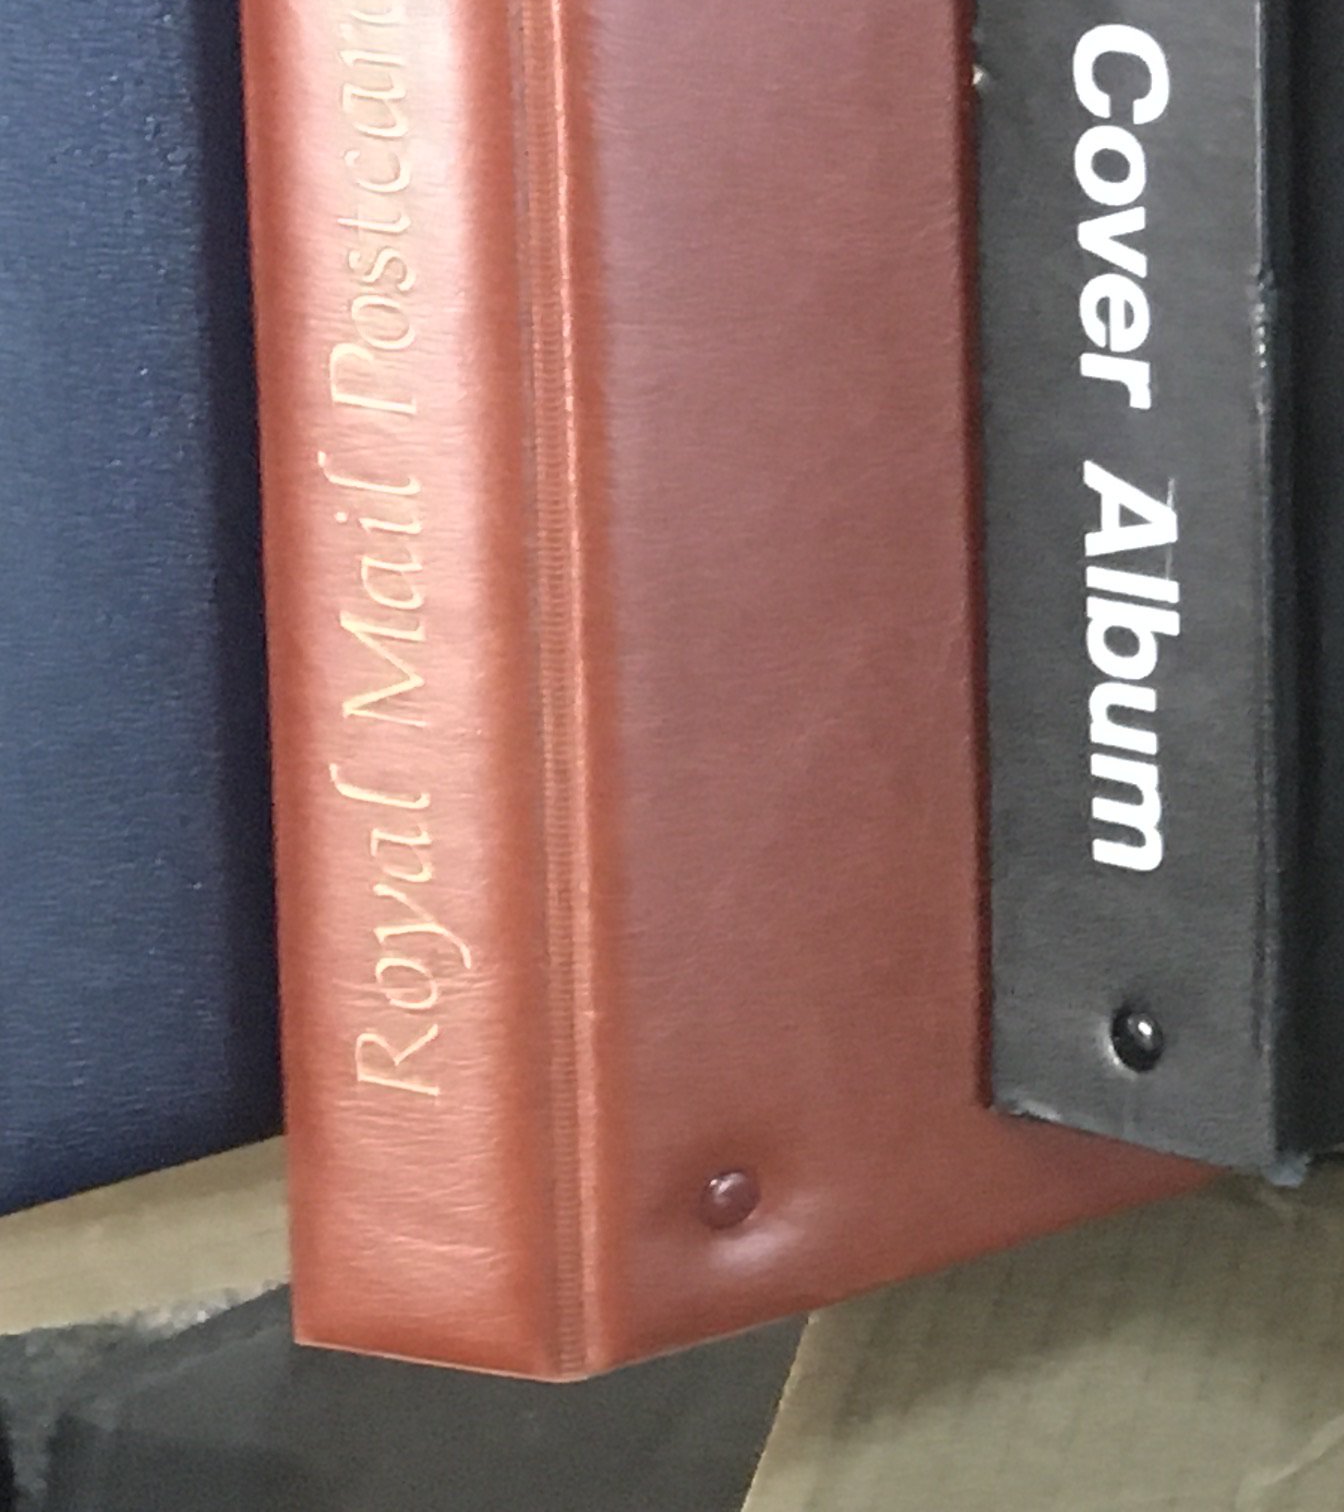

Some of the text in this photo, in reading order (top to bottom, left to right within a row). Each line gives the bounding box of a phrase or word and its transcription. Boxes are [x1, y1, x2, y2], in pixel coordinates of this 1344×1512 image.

[317, 449, 429, 729] Mail
[1072, 23, 1181, 872] Cover Album
[329, 762, 472, 1097] Royal
